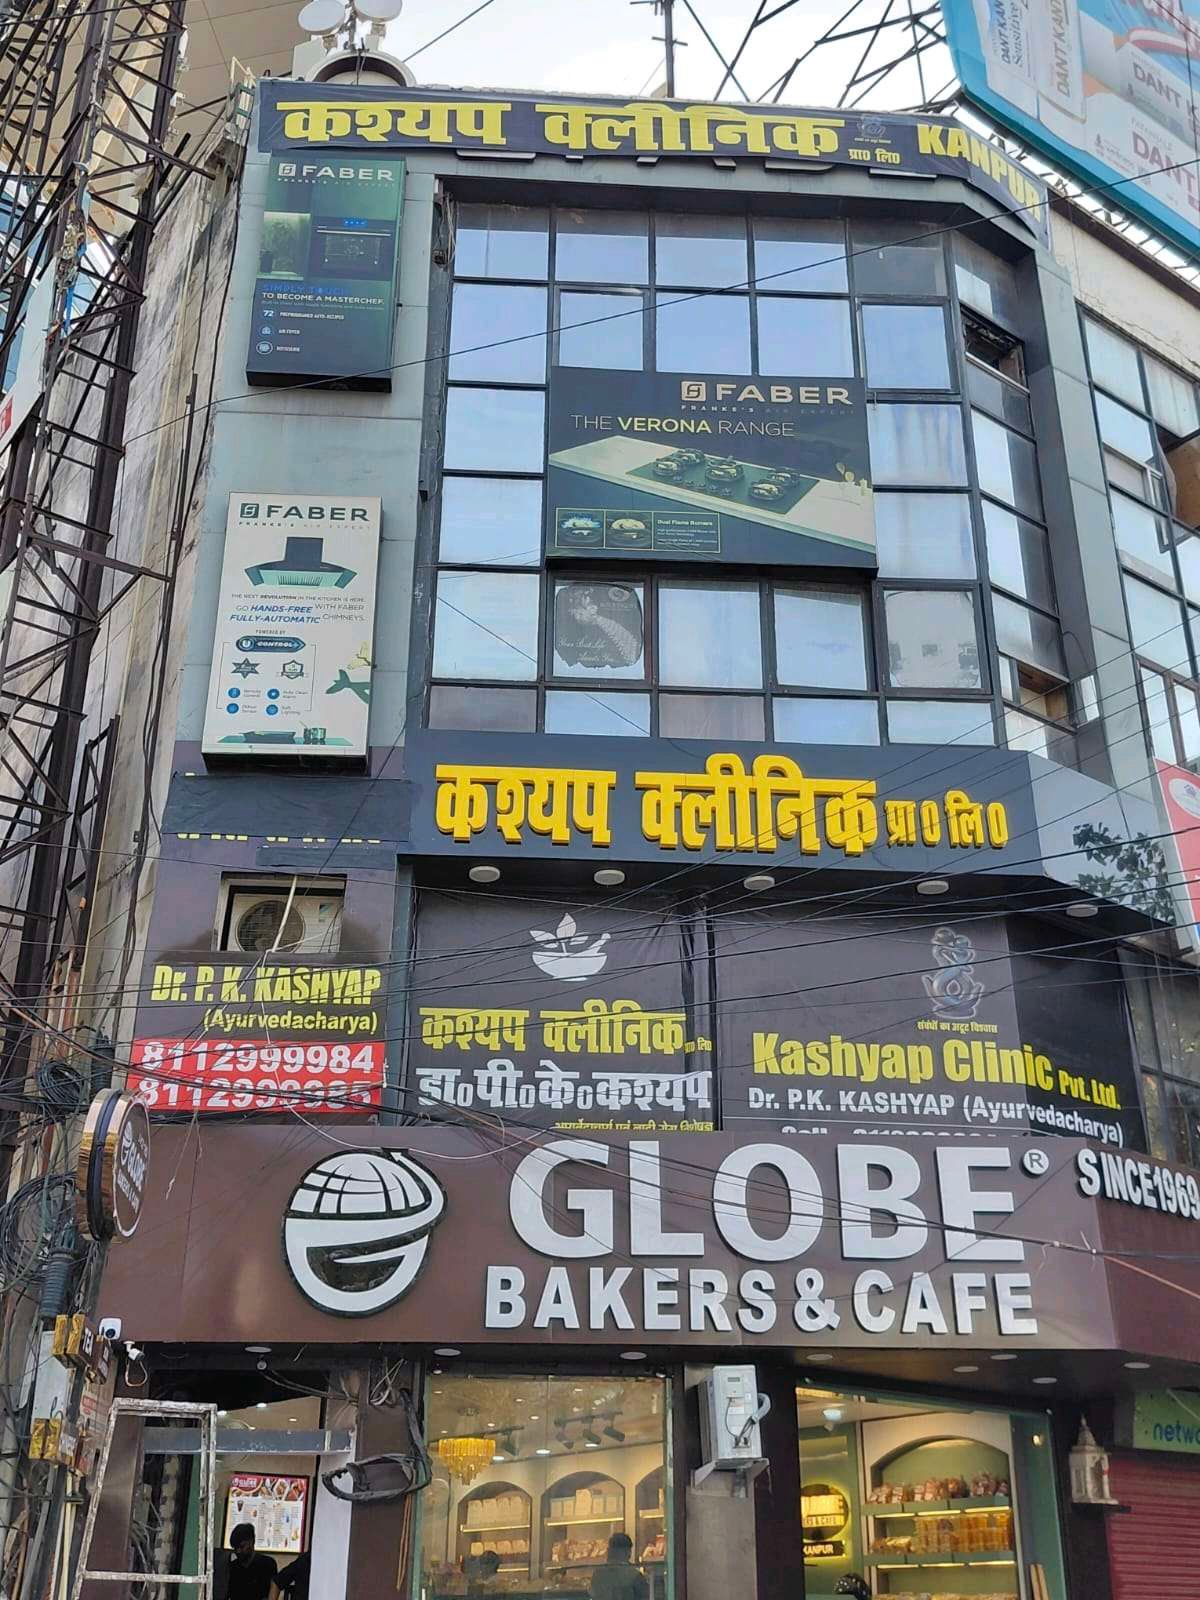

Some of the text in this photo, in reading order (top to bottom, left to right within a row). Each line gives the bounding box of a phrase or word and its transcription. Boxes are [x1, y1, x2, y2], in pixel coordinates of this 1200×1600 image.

[1133, 62, 1182, 108] DANT
[276, 101, 512, 145] कश्यप
[534, 101, 845, 157] क्लीनिक
[302, 165, 394, 181] FABER
[917, 123, 1041, 222] KANPUR
[263, 309, 274, 317] 72
[277, 293, 313, 301] BECOME
[716, 384, 853, 405] FABER
[570, 414, 796, 437] THE VERONA RANGE
[266, 504, 370, 522] FABER
[230, 614, 321, 624] FULLY-AUTOMATIC
[235, 604, 249, 612] GO
[250, 604, 313, 613] HANDS-FREE
[435, 764, 617, 848] कश्यप
[635, 753, 877, 856] क्लीनिक
[151, 965, 381, 1005] Dr. P. K. KASHYAP
[203, 1008, 378, 1035] (Ayurvedacharya)
[419, 1007, 529, 1051] कश्यप
[540, 998, 686, 1054] क्लीनिक
[142, 1042, 374, 1073] 8112999984
[752, 1032, 1121, 1111] Kashyap Clinic Pvt. Ltd.
[749, 1087, 780, 1110] Dr.
[788, 1088, 831, 1111] P.K.
[840, 1090, 955, 1116] KASHYAP
[963, 1097, 1123, 1149] (Ayurvedacharya)
[510, 1139, 1025, 1262] GLOBE
[485, 1265, 1039, 1335] BAKERS & CAFE
